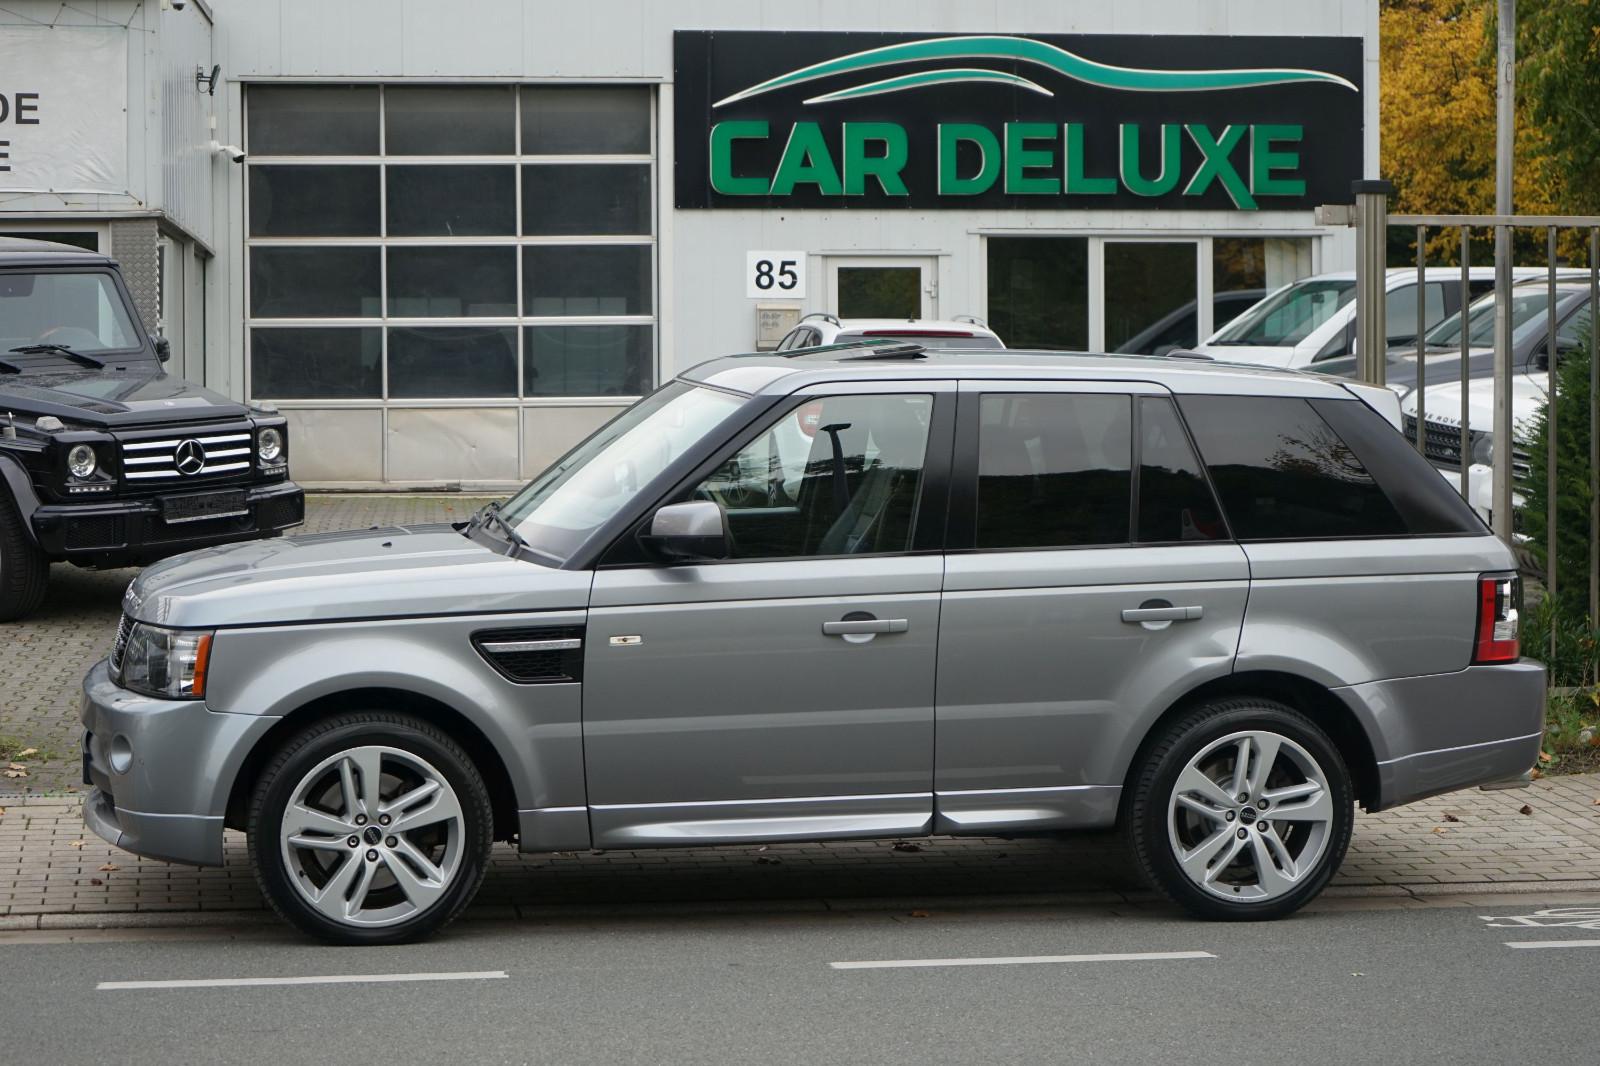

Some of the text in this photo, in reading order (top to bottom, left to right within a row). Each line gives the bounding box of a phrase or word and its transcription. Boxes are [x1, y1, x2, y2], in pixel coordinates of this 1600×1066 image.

[709, 120, 1307, 211] CAR DELUXE
[755, 259, 799, 290] 85
